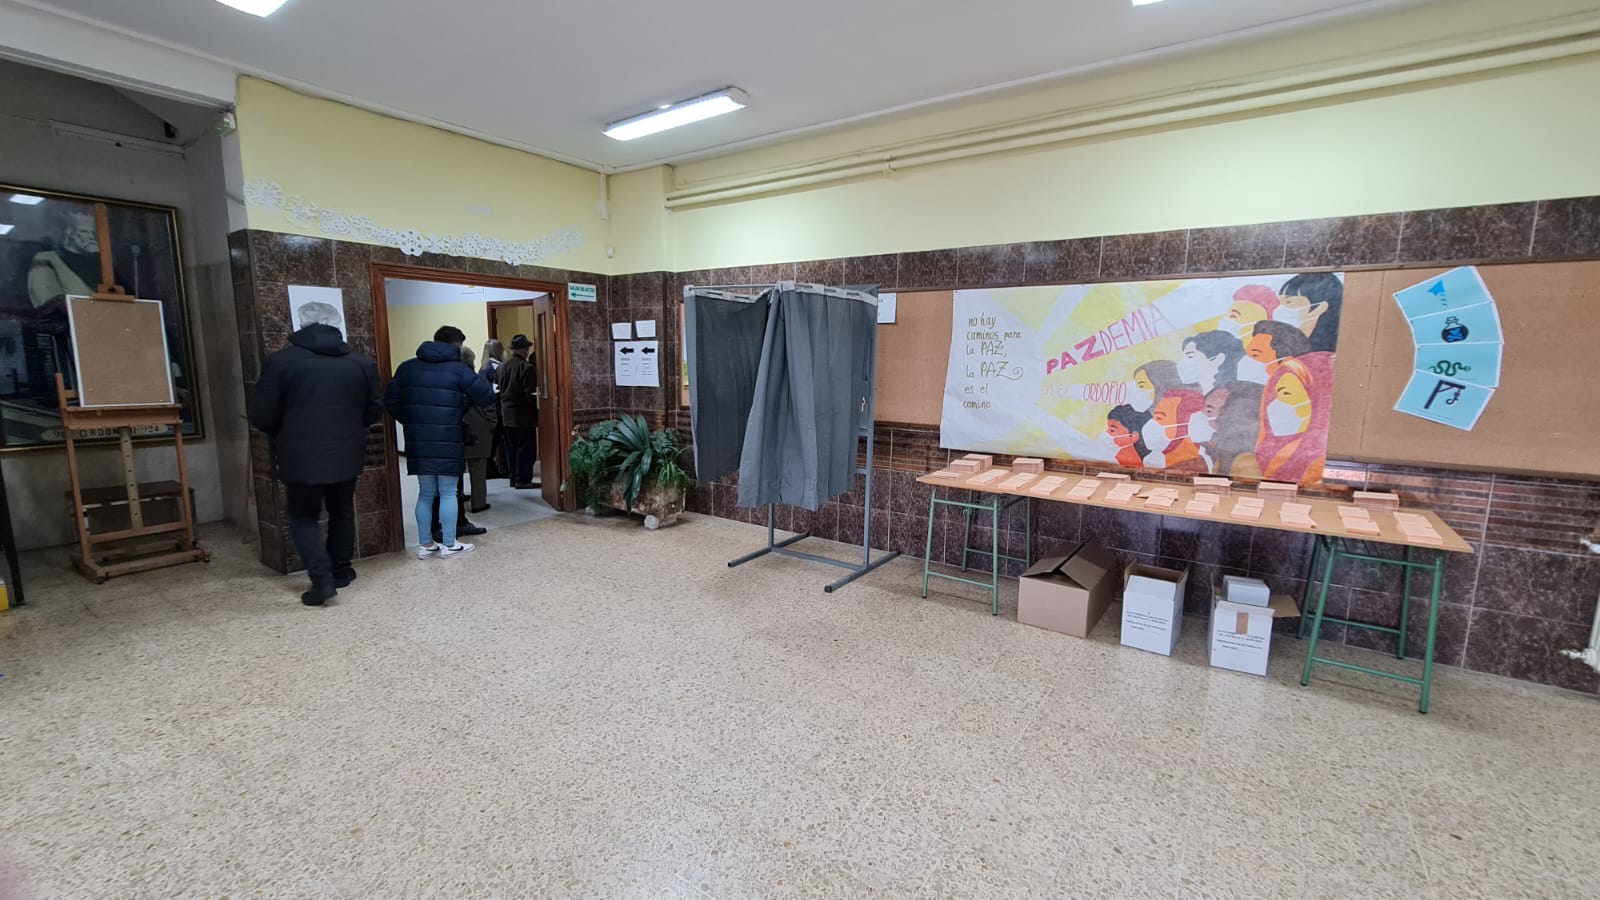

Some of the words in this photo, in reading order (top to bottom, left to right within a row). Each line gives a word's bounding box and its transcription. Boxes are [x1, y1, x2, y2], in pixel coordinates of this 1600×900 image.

[968, 316, 978, 327] no
[980, 312, 997, 329] hay
[966, 345, 975, 356] la
[966, 364, 975, 379] la
[980, 360, 1024, 381] PAZ
[964, 385, 974, 394] es
[979, 382, 989, 395] el
[962, 400, 992, 409] camino
